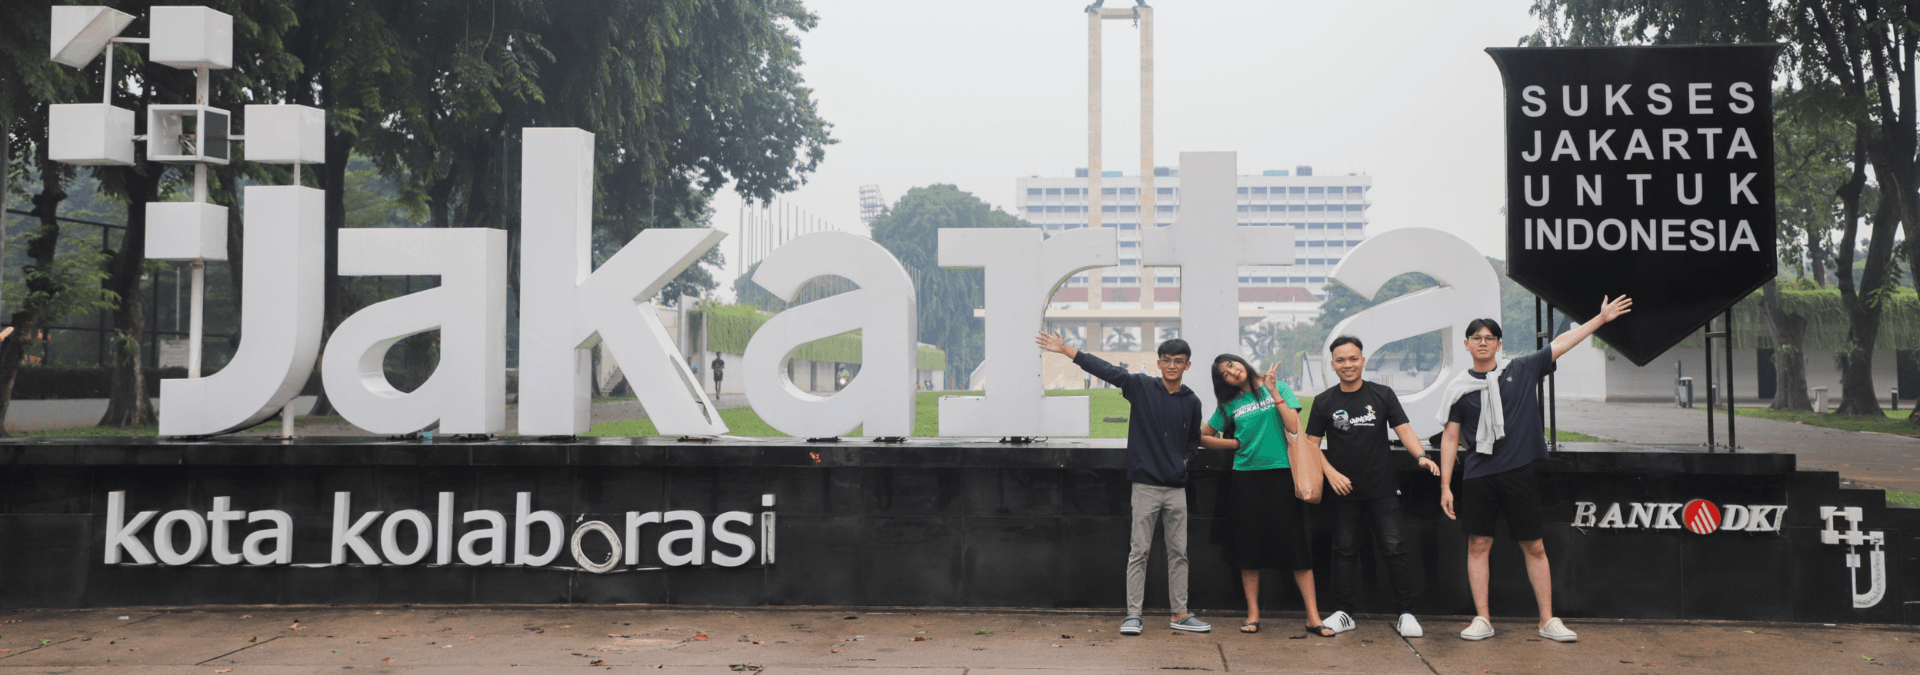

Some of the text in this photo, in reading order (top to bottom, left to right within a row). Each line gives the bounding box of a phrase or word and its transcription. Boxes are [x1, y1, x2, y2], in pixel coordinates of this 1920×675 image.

[1521, 81, 1755, 118] SUKSES
[1521, 127, 1758, 163] JAKARTA
[1523, 172, 1759, 207] UNTUK
[1524, 218, 1760, 252] INDONESIA
[104, 490, 776, 574] kota kolaborasi
[1571, 501, 1788, 532] BANK DKI
